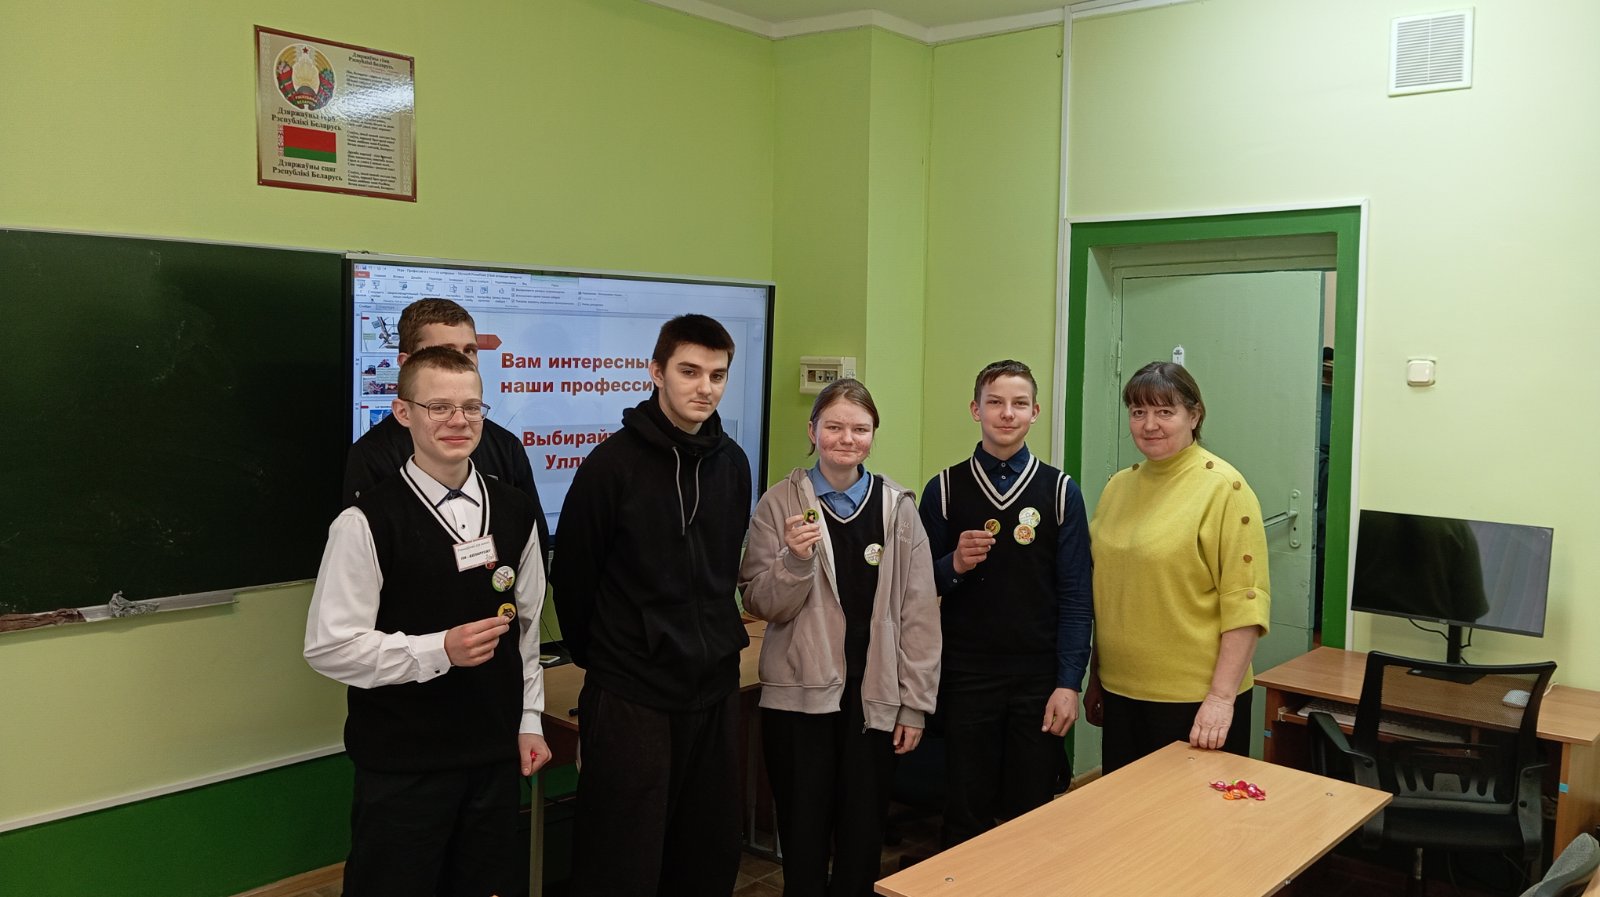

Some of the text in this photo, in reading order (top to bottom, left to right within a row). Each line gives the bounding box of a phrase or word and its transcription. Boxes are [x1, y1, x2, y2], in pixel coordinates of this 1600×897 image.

[277, 107, 319, 119] Дзяржаўны
[271, 114, 309, 126] Рэспублікі
[310, 121, 342, 131] Беларусь
[272, 166, 310, 177] Рэспублікі
[311, 171, 343, 182] Беларусь
[278, 159, 336, 173] Дзяржаўны сцяг
[501, 352, 649, 373] Вам интересны
[500, 381, 554, 393] наши
[545, 454, 586, 470] Улл
